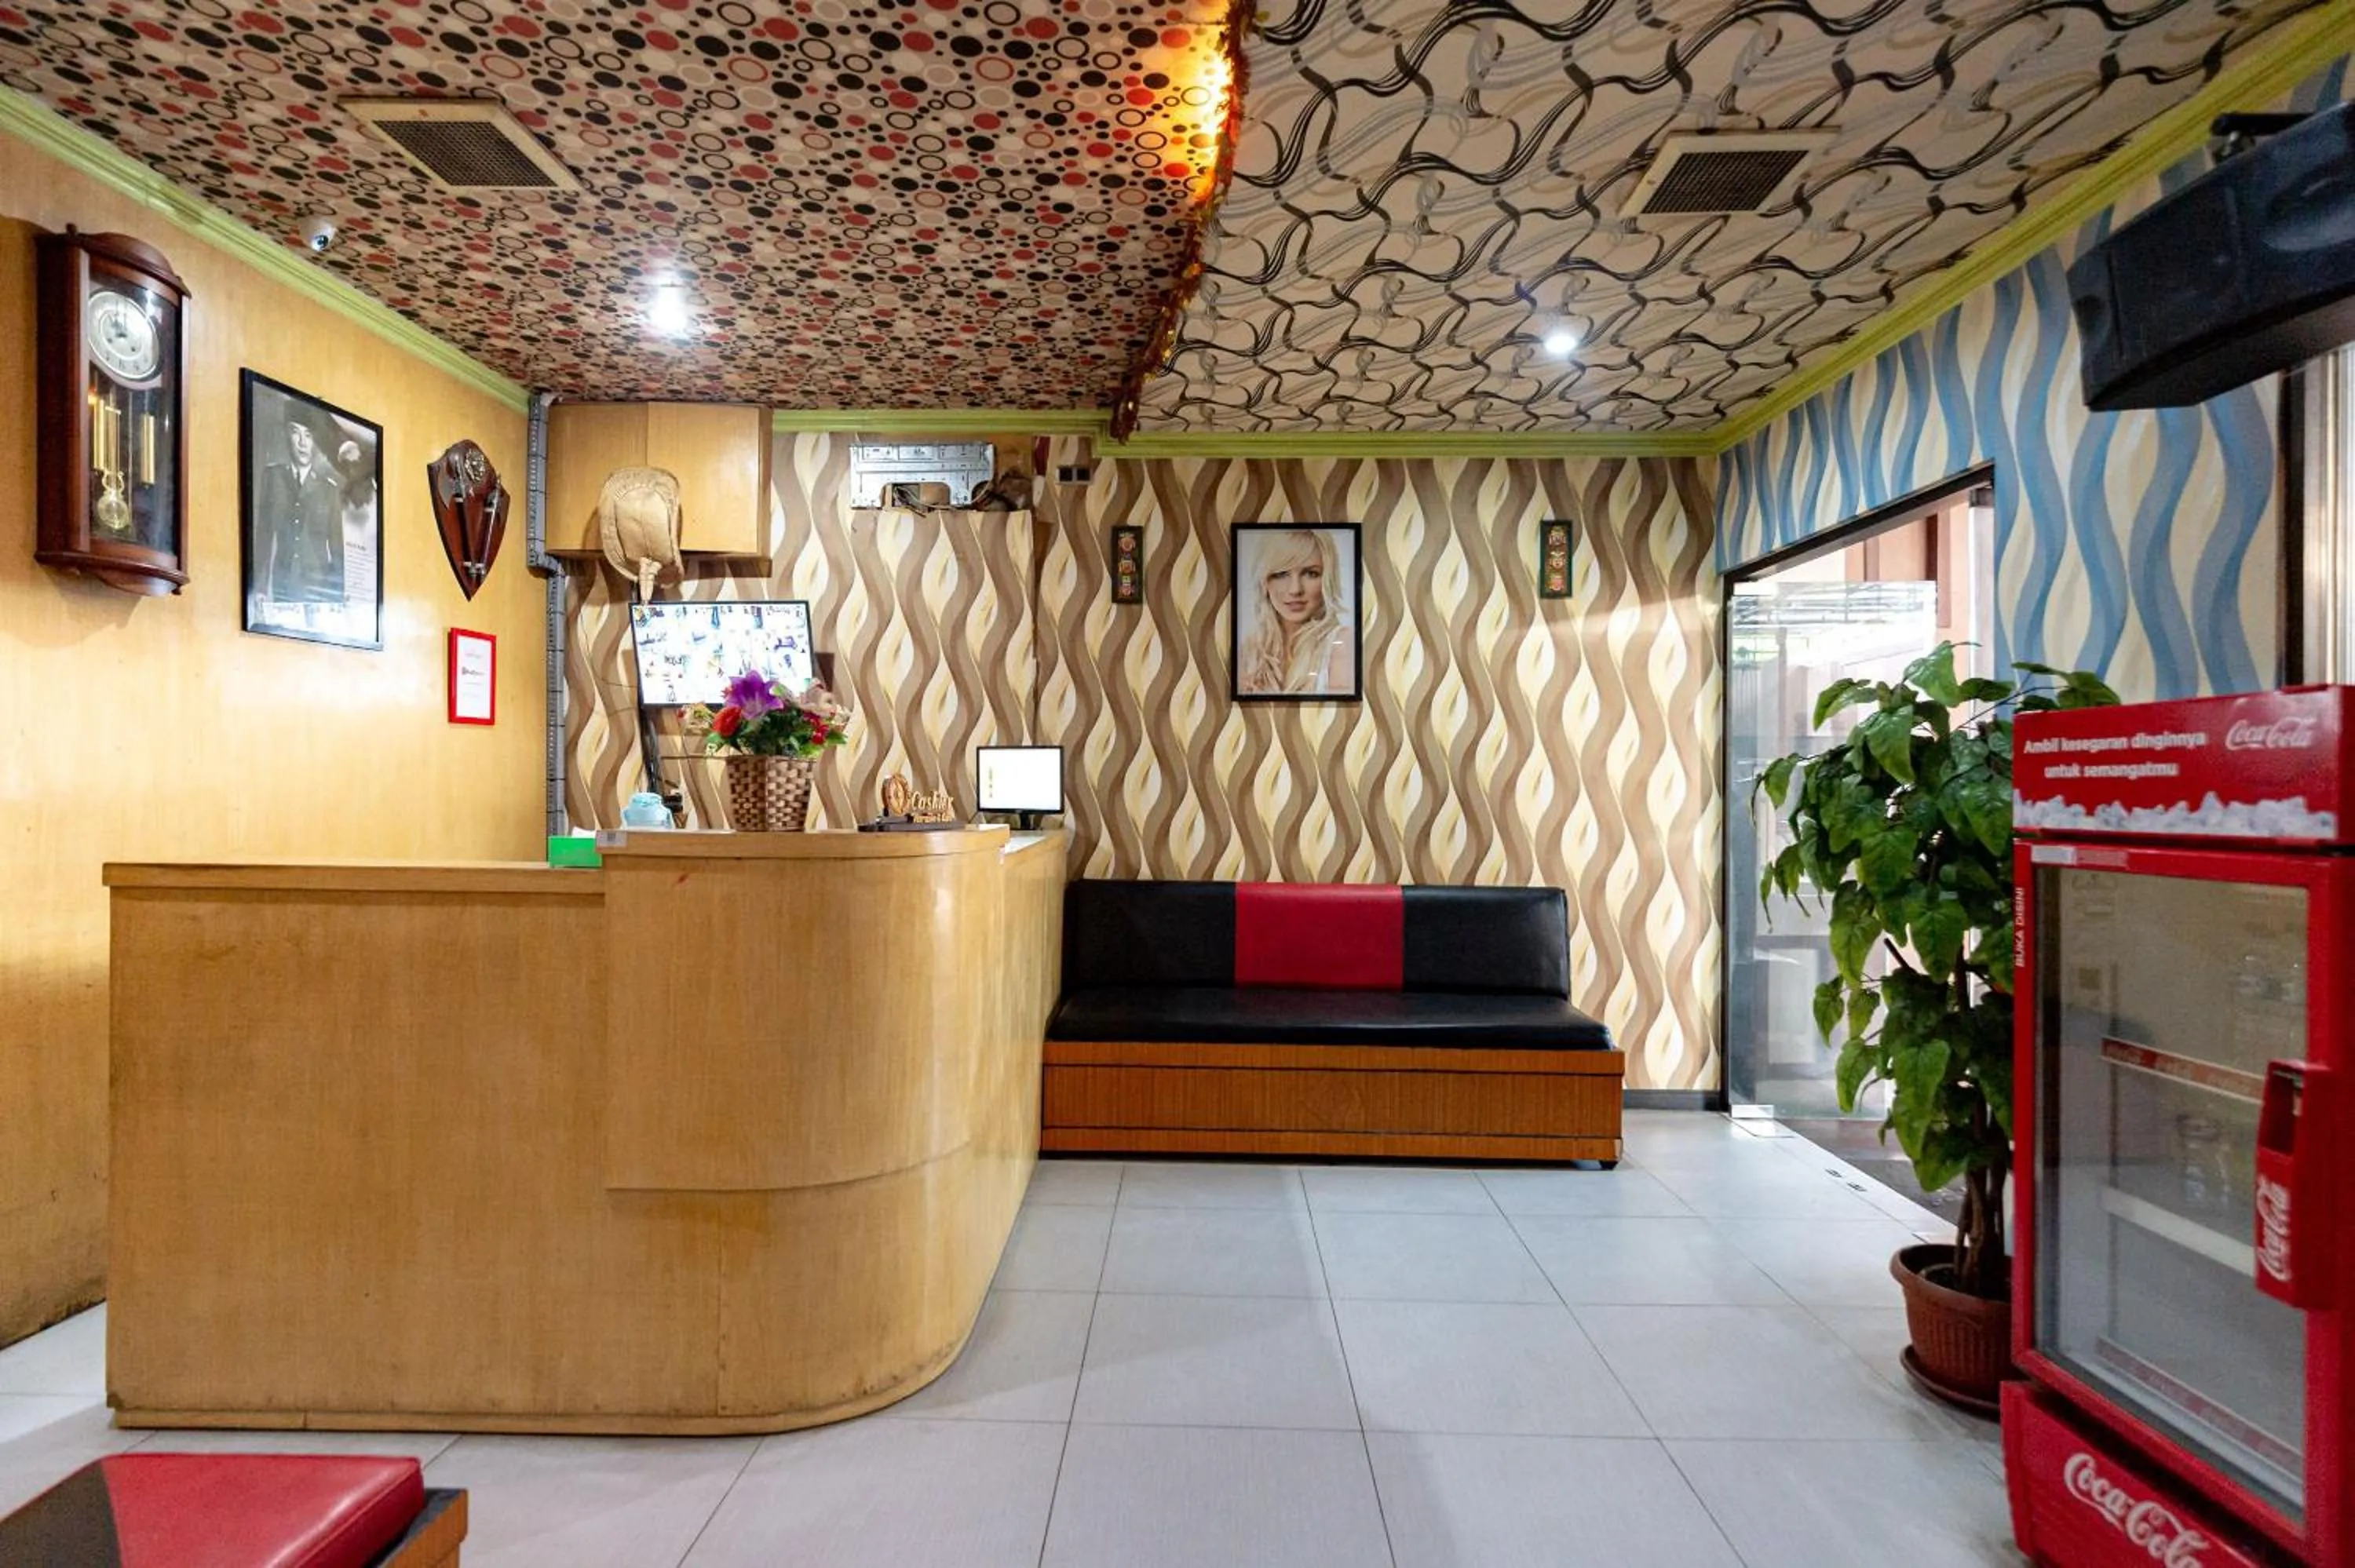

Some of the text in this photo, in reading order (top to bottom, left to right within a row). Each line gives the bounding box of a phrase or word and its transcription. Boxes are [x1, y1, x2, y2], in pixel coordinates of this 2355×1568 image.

[2023, 730, 2207, 754] Ambil kesegaran dinginnya
[2043, 760, 2179, 779] untuk semangatmu
[2014, 929, 2025, 967] BUKA
